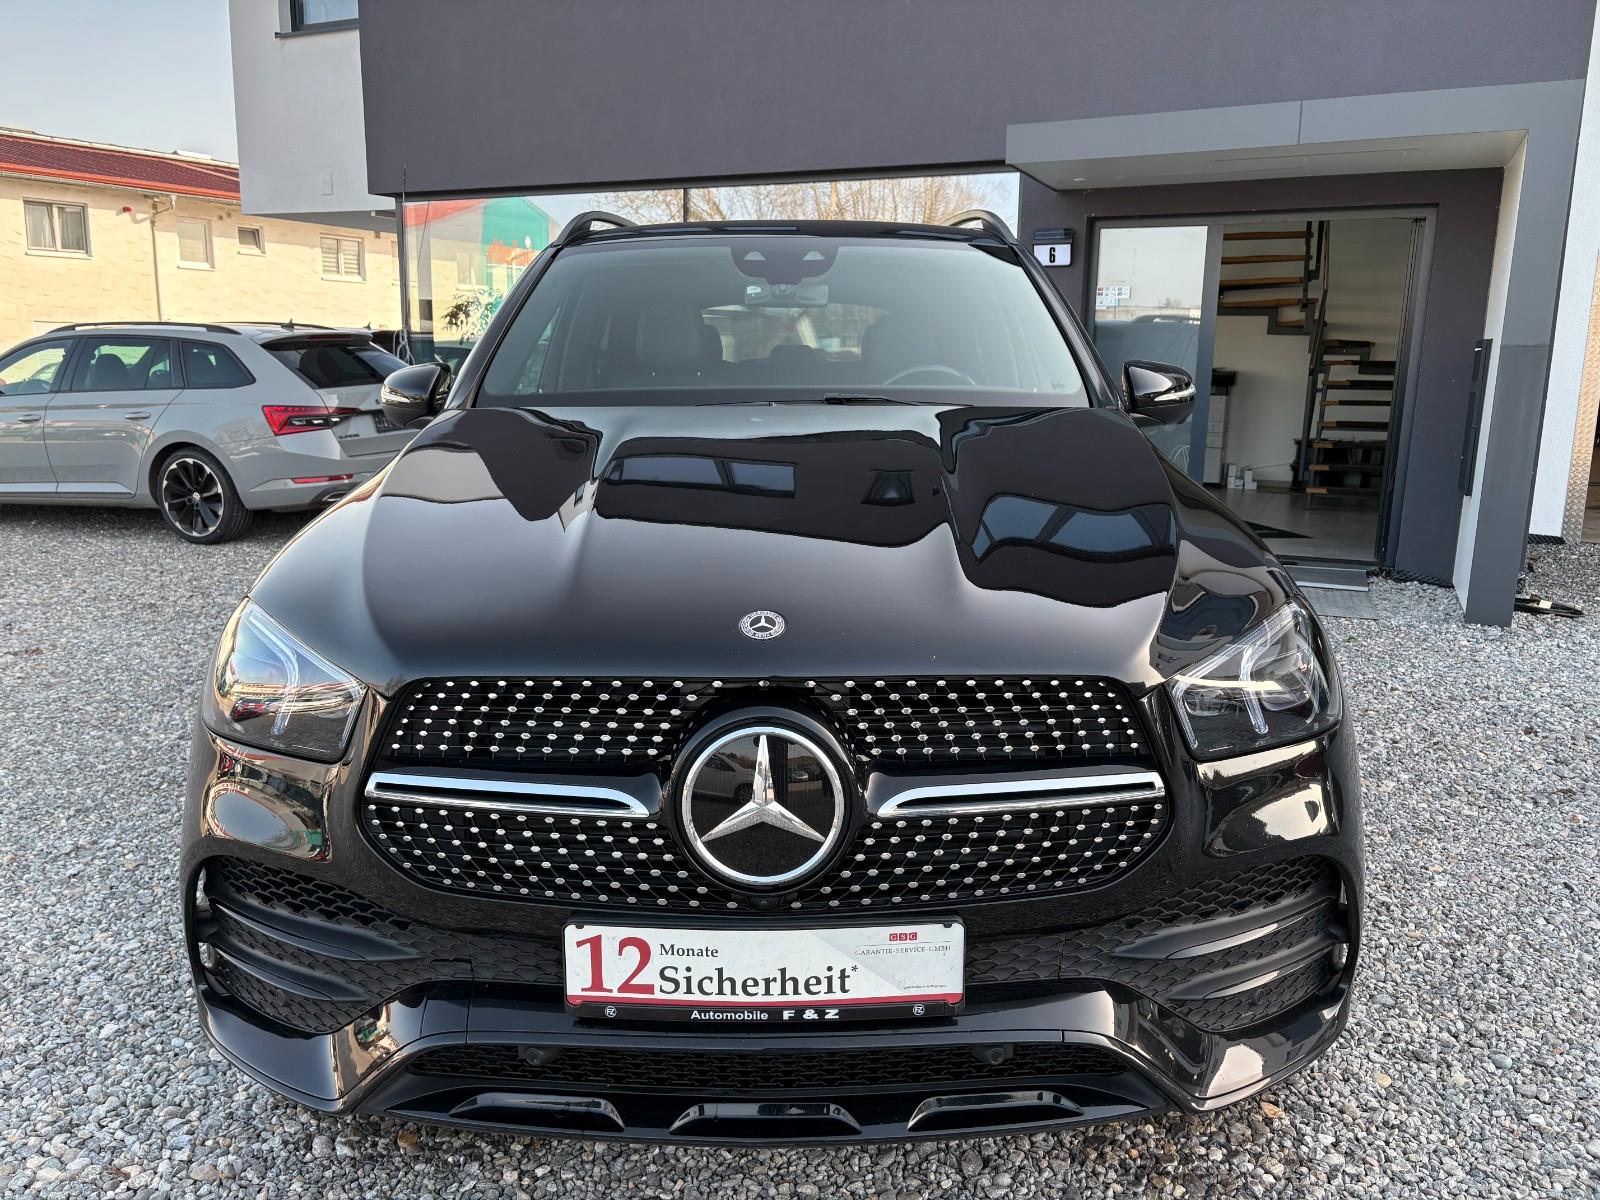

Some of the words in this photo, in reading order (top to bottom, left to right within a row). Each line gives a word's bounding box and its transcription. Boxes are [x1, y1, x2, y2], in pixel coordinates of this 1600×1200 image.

[1049, 246, 1056, 264] 6
[889, 931, 918, 941] GSG
[659, 943, 719, 958] Monate
[575, 934, 655, 995] 12
[690, 1010, 769, 1021] Automobile
[782, 1010, 795, 1020] F
[802, 1009, 819, 1020] &
[825, 1008, 840, 1019] Z
